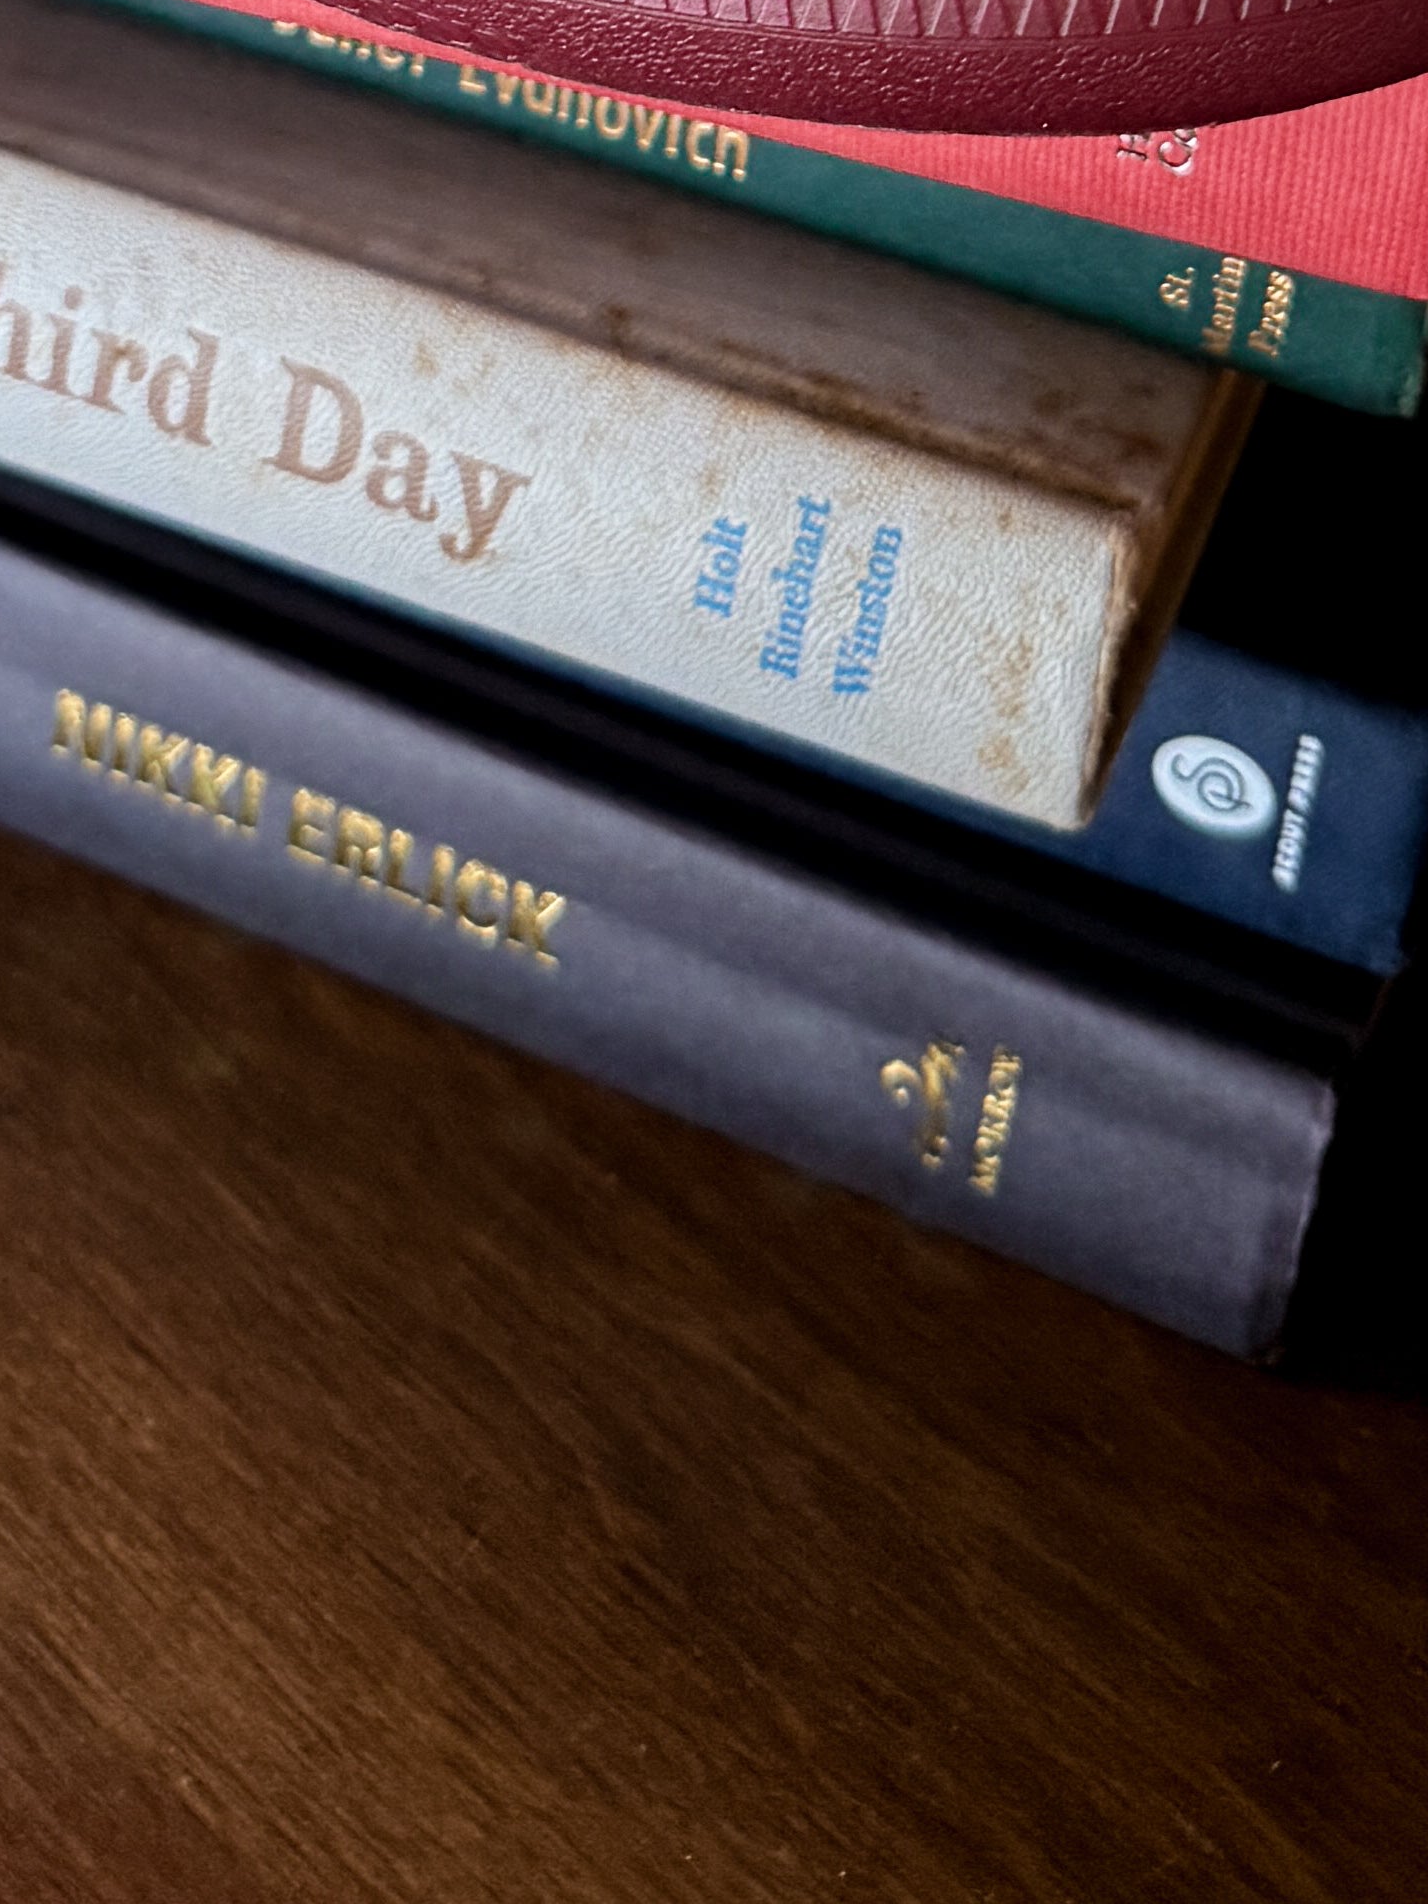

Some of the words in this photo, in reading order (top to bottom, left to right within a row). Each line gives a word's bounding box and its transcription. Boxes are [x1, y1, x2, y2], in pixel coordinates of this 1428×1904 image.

[1158, 266, 1196, 311] St.
[1248, 270, 1296, 359] Press
[262, 355, 533, 563] Day
[693, 515, 748, 619] Holt
[758, 493, 832, 681] Rinehart
[831, 523, 903, 695] Winston
[49, 687, 268, 839] NIKKI
[285, 787, 567, 971] ERLICK
